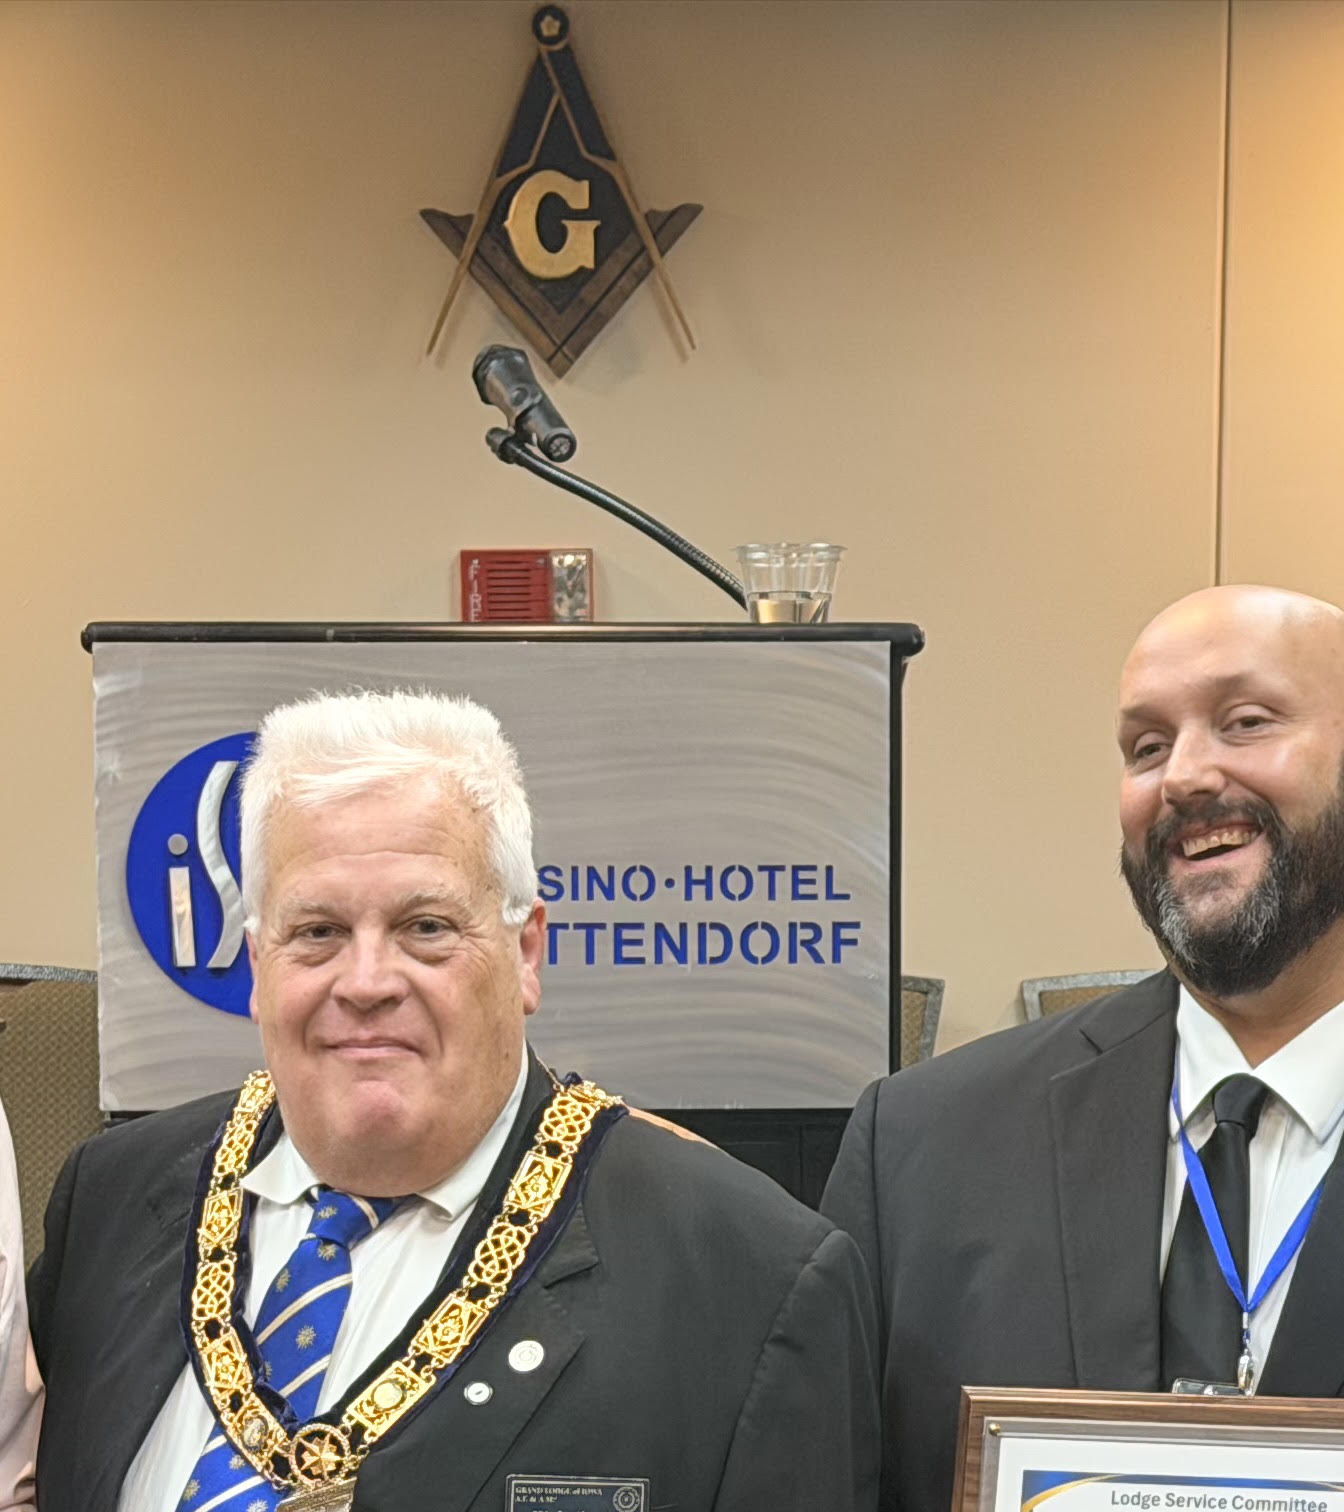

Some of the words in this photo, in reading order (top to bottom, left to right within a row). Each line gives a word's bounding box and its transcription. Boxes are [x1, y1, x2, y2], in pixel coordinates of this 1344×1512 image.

[503, 169, 601, 279] G
[1111, 1490, 1161, 1510] Lodge
[1165, 1493, 1228, 1509] Service
